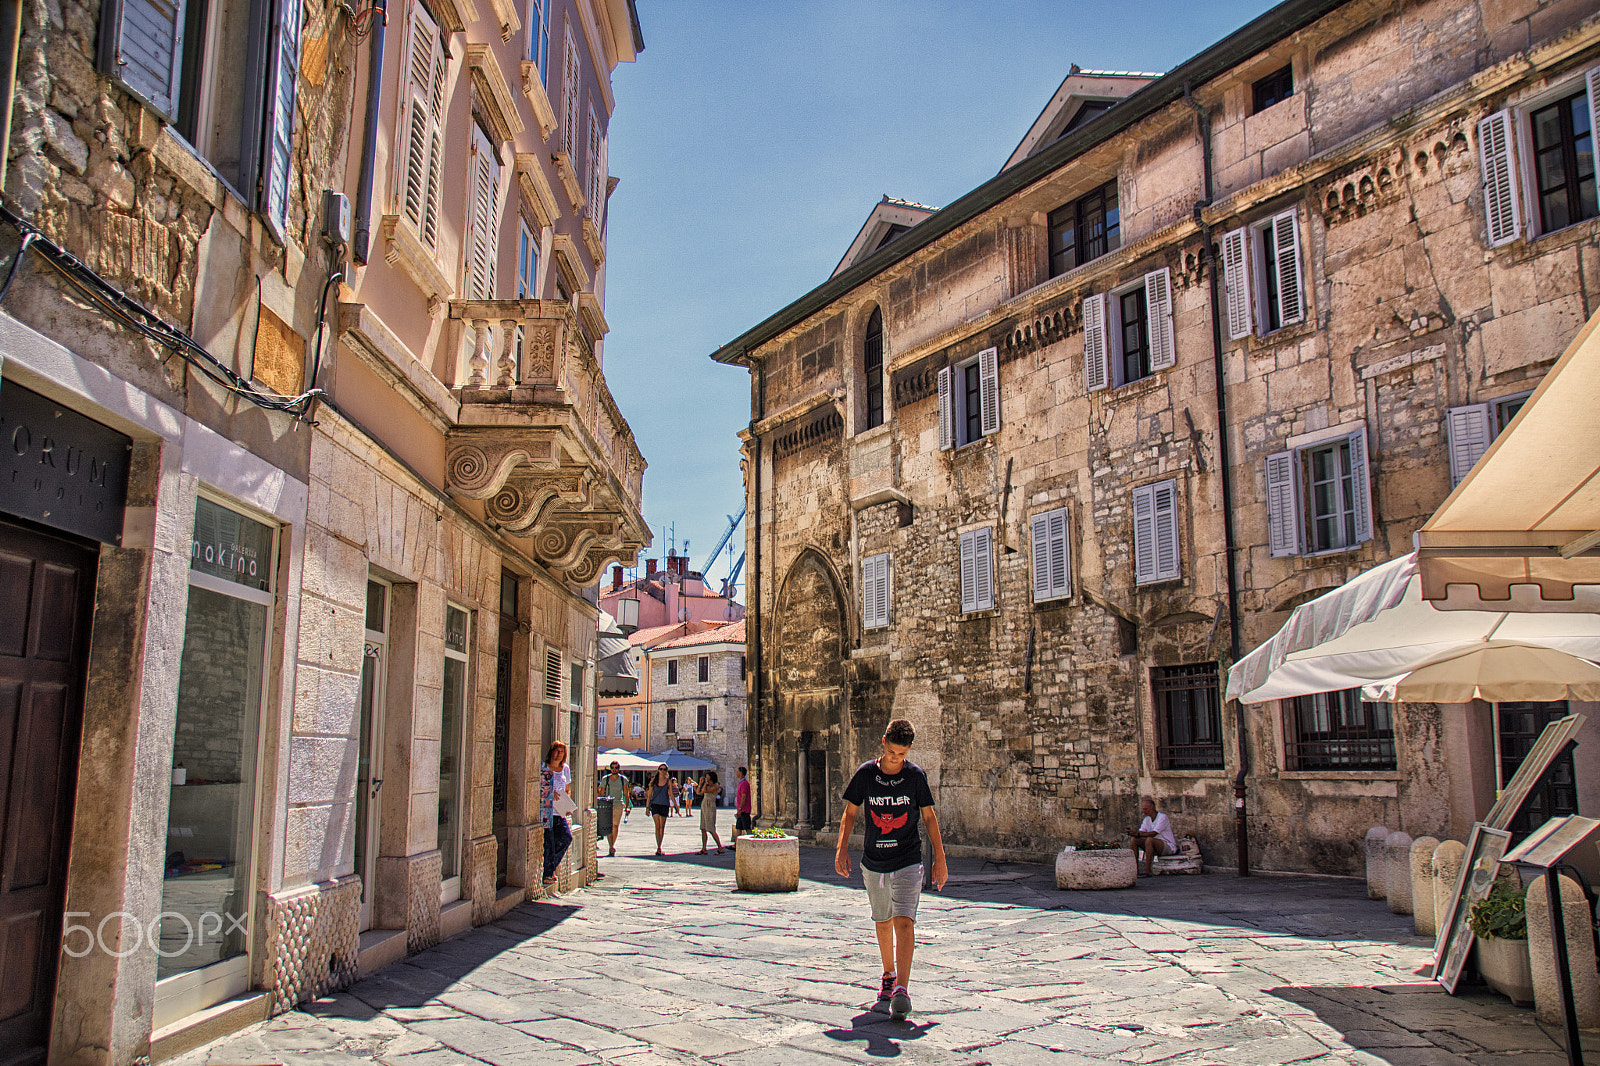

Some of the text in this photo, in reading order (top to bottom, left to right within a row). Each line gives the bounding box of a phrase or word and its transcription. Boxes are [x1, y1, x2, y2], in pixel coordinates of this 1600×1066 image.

[0, 417, 110, 488] ORUM
[10, 469, 105, 513] TUDIO
[868, 795, 911, 806] HUSTLER
